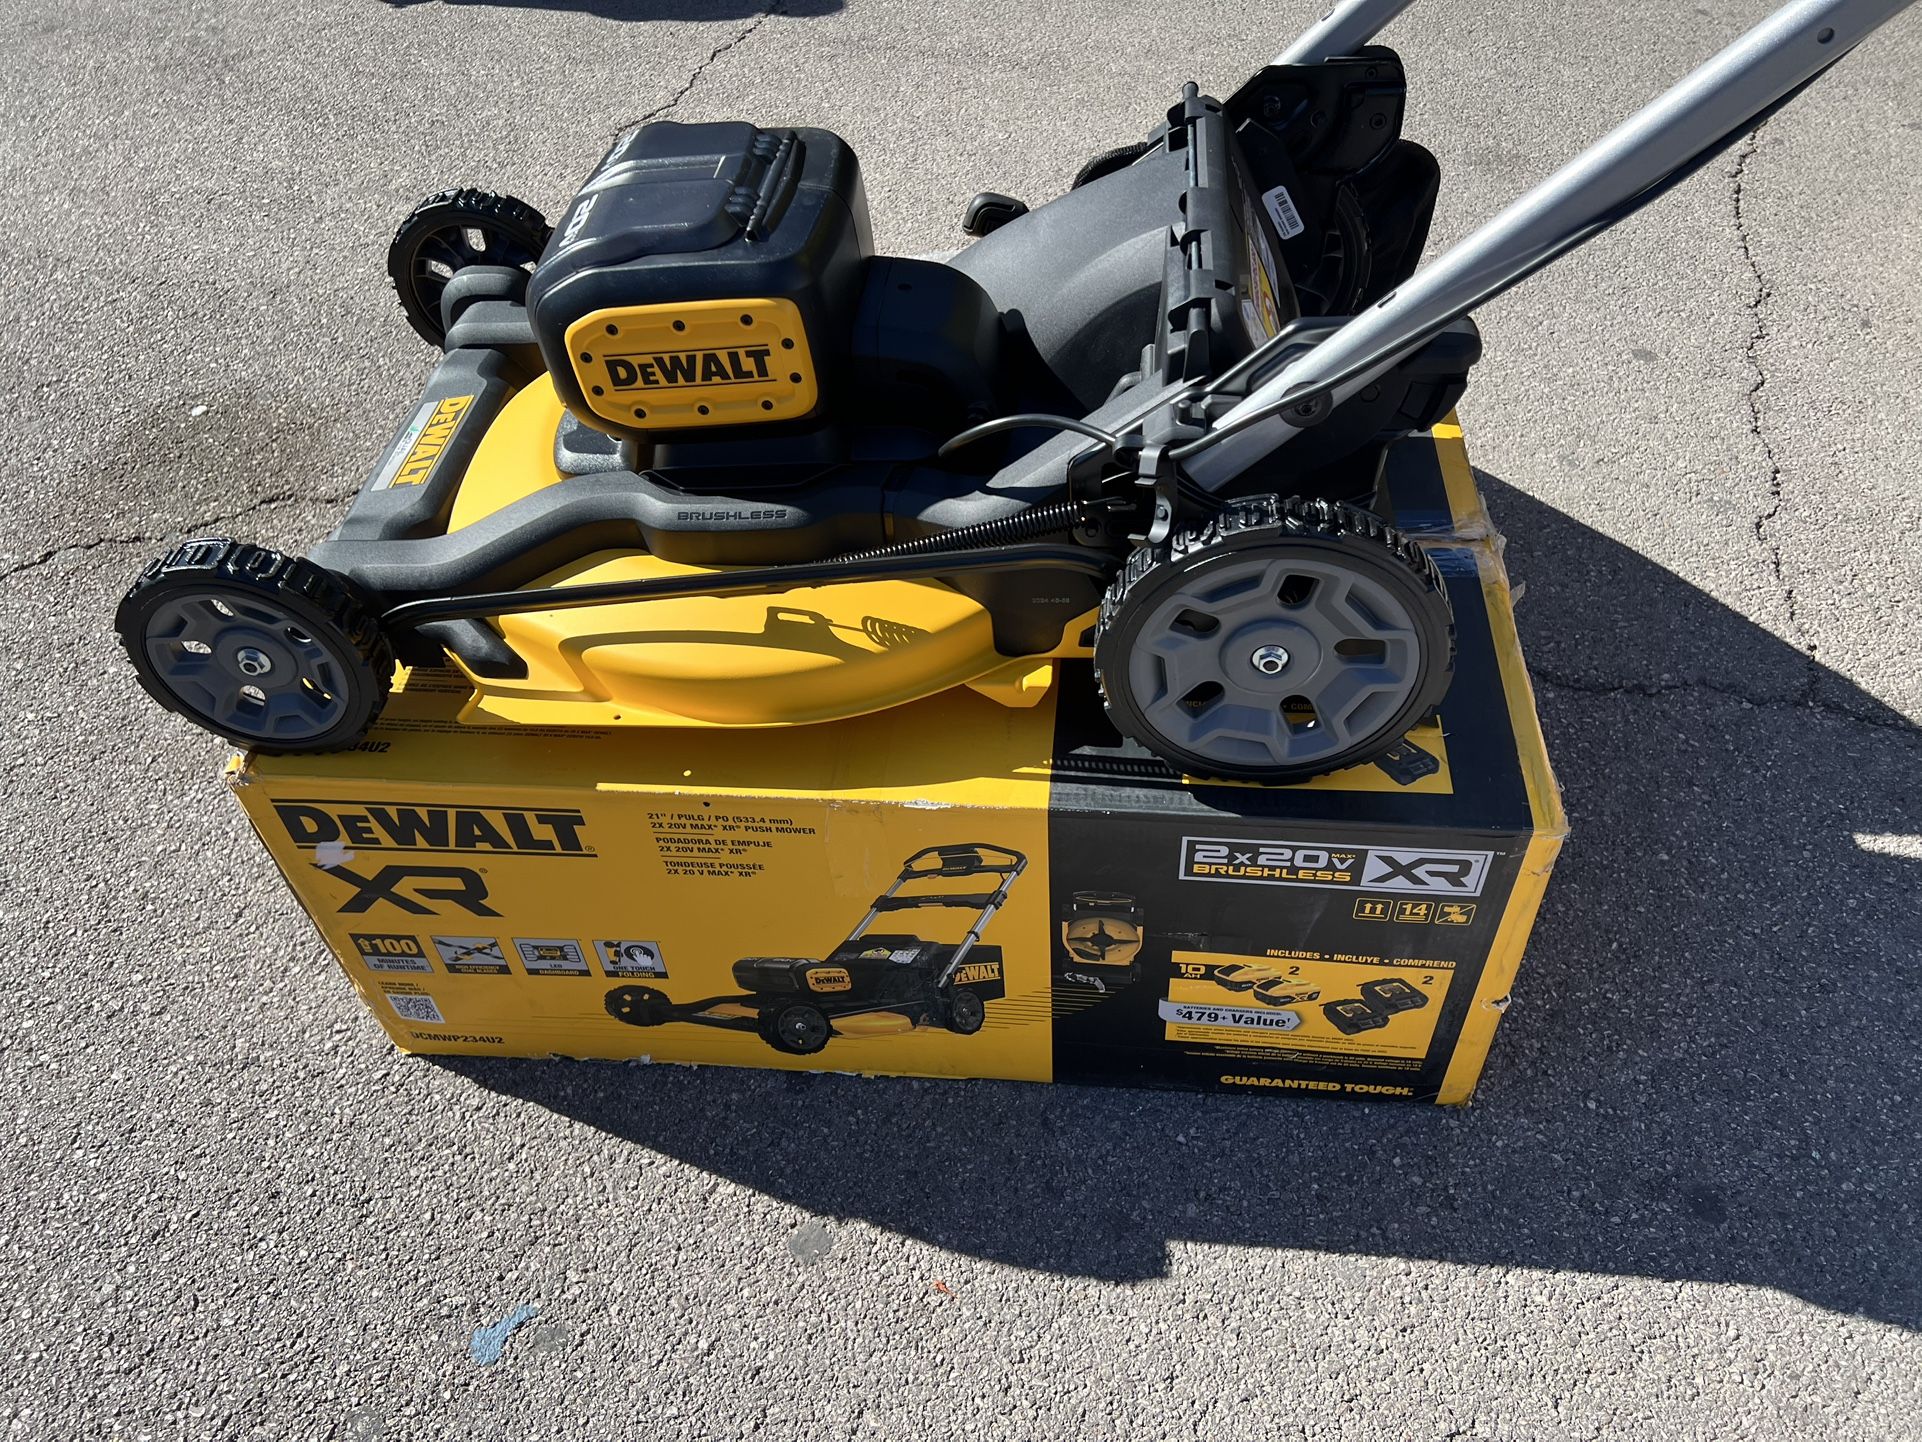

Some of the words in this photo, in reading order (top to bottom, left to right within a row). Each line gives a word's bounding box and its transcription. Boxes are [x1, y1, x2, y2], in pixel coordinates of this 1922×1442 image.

[677, 509, 787, 521] BRUSHLESS
[677, 814, 705, 822] PULG
[732, 815, 767, 824] (533.4
[769, 817, 793, 826] mm)
[744, 825, 772, 833] PUSH
[775, 826, 816, 835] MOWER
[655, 837, 712, 846] PODADORA
[731, 839, 773, 848] EMPUJE
[658, 845, 672, 853] 2X
[663, 860, 716, 869] TONDEUSE
[719, 861, 765, 871] POUSSÉE
[1192, 864, 1351, 882] BRUSHLESS
[1402, 903, 1428, 916] 14
[373, 937, 419, 954] 100
[1266, 949, 1321, 960] INCLUDES
[1333, 954, 1381, 964] INCLUYE
[1393, 958, 1457, 968] COMPREND
[1179, 963, 1206, 974] 10
[1288, 966, 1300, 976] 2
[1421, 975, 1435, 985] 2
[1220, 1075, 1341, 1091] GUARANTEED
